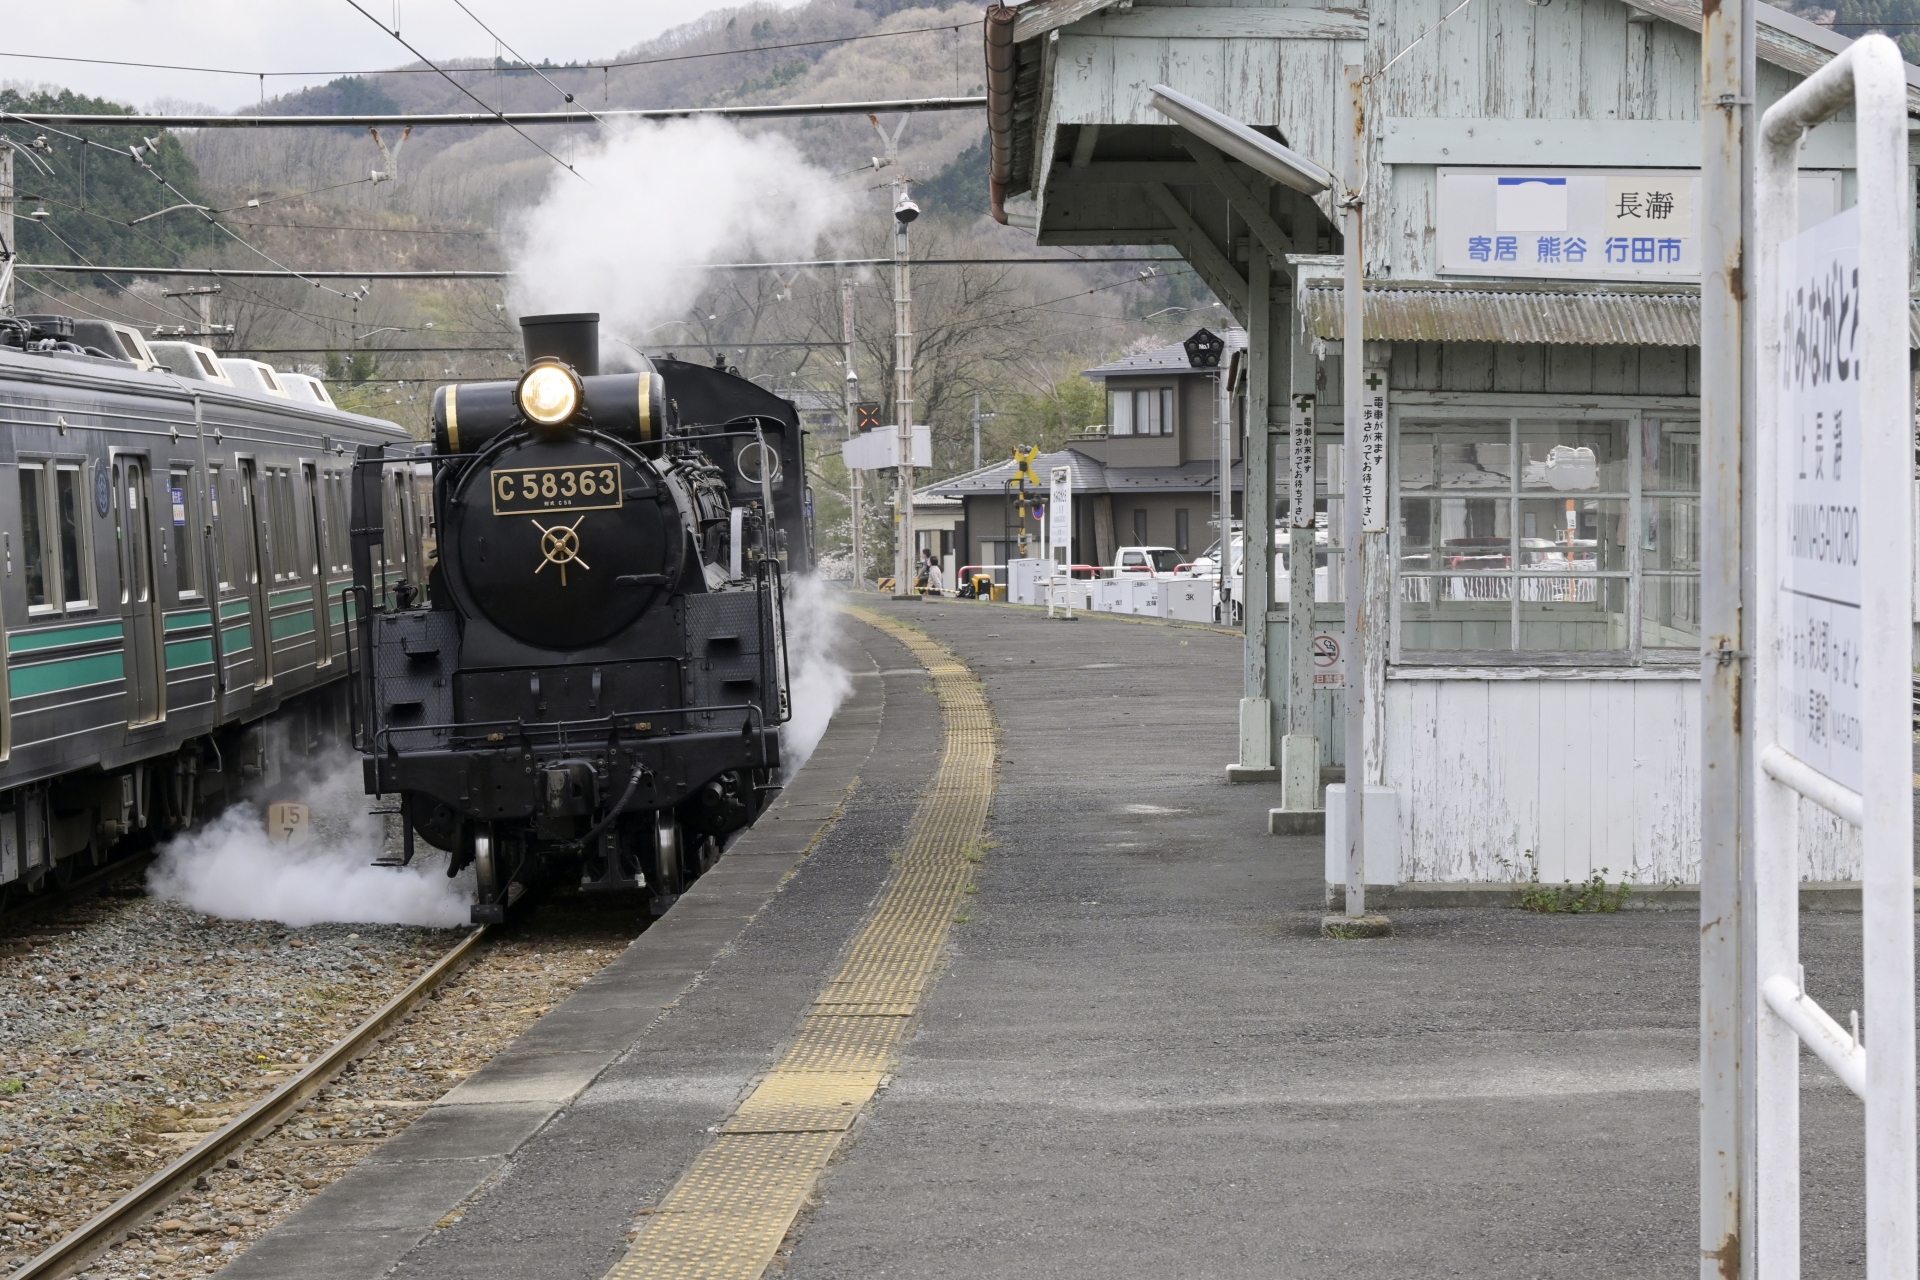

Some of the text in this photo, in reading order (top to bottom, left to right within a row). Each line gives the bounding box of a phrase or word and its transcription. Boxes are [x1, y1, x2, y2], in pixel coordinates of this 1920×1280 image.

[1615, 191, 1674, 219] 長瀞
[1468, 235, 1682, 263] 寄居 熊谷 行田市
[1304, 417, 1312, 474] 電車が来ます
[1373, 397, 1383, 466] 電車が来ます
[1799, 409, 1843, 481] 上長瀞
[1294, 423, 1303, 523] 一歩さがってお待ち下さい
[1363, 404, 1372, 526] 一歩さがってお待ち下さい
[1185, 593, 1195, 601] 3K
[1314, 674, 1344, 684] 日禁煙
[280, 805, 300, 825] 15
[283, 827, 294, 845] 7
